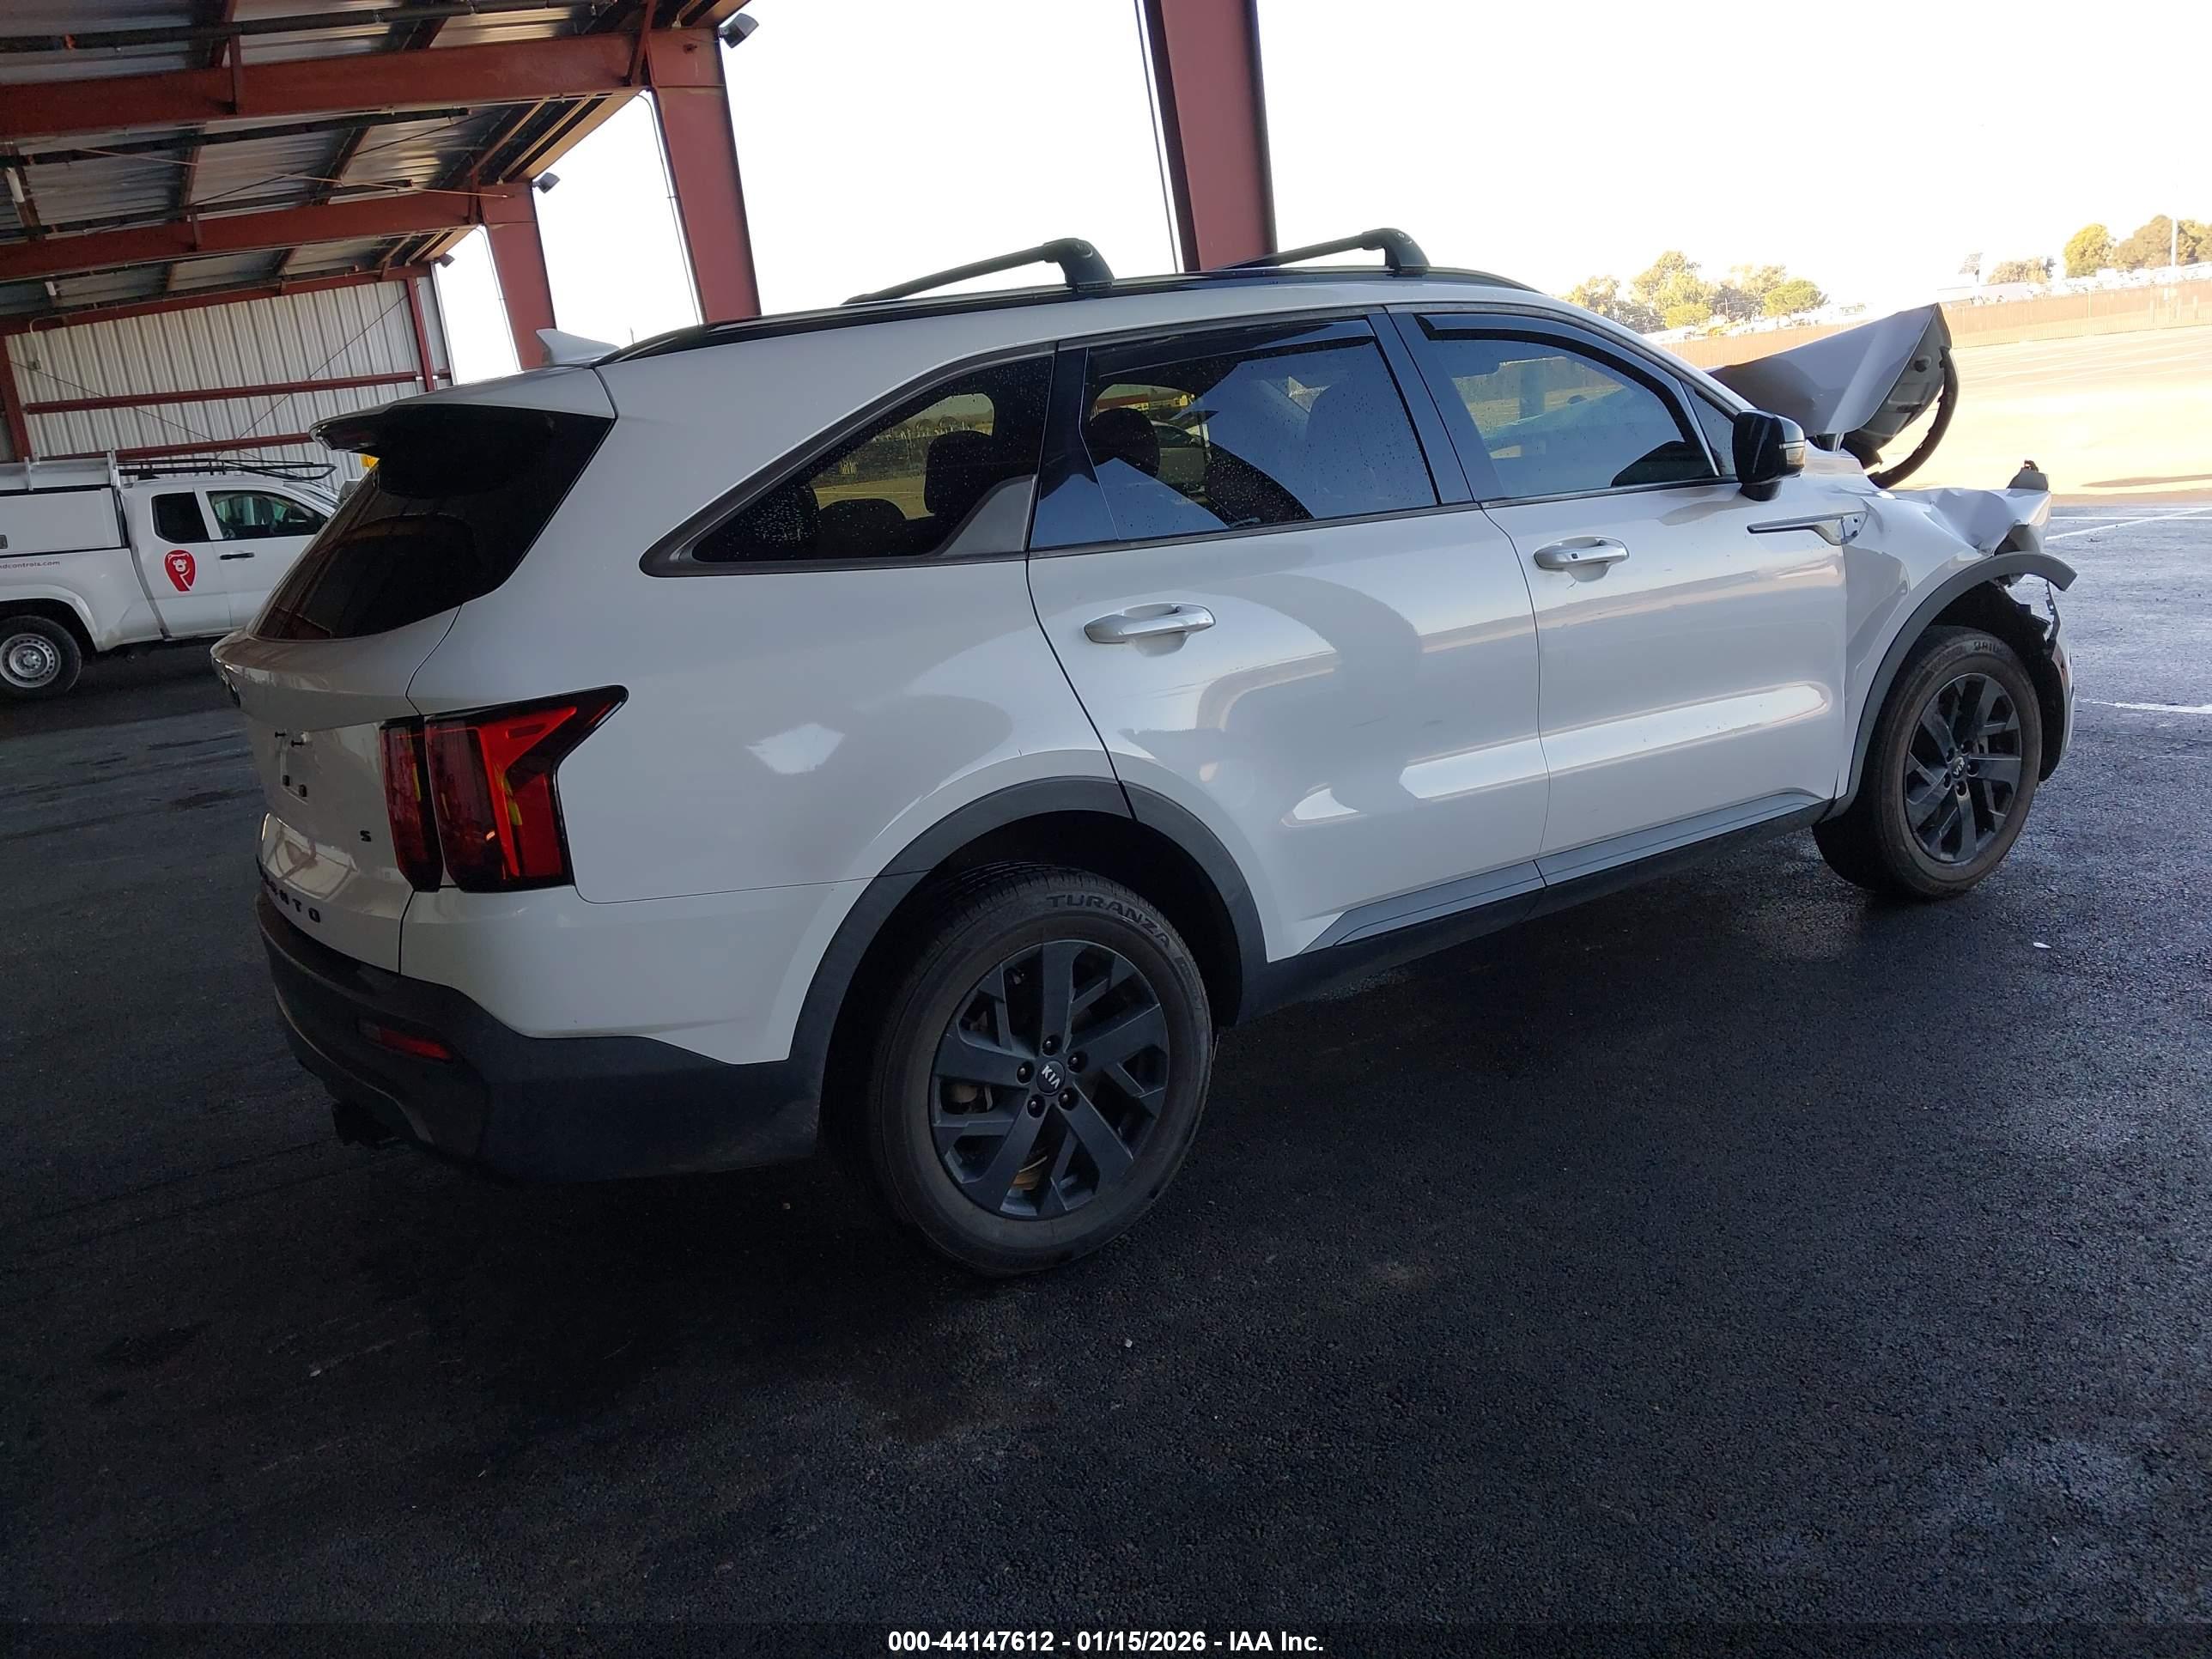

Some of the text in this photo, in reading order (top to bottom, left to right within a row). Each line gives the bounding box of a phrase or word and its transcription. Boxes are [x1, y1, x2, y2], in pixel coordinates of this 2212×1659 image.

[360, 830, 371, 842] S
[1046, 894, 1170, 950] TURANZA
[1042, 1065, 1060, 1090] KIA
